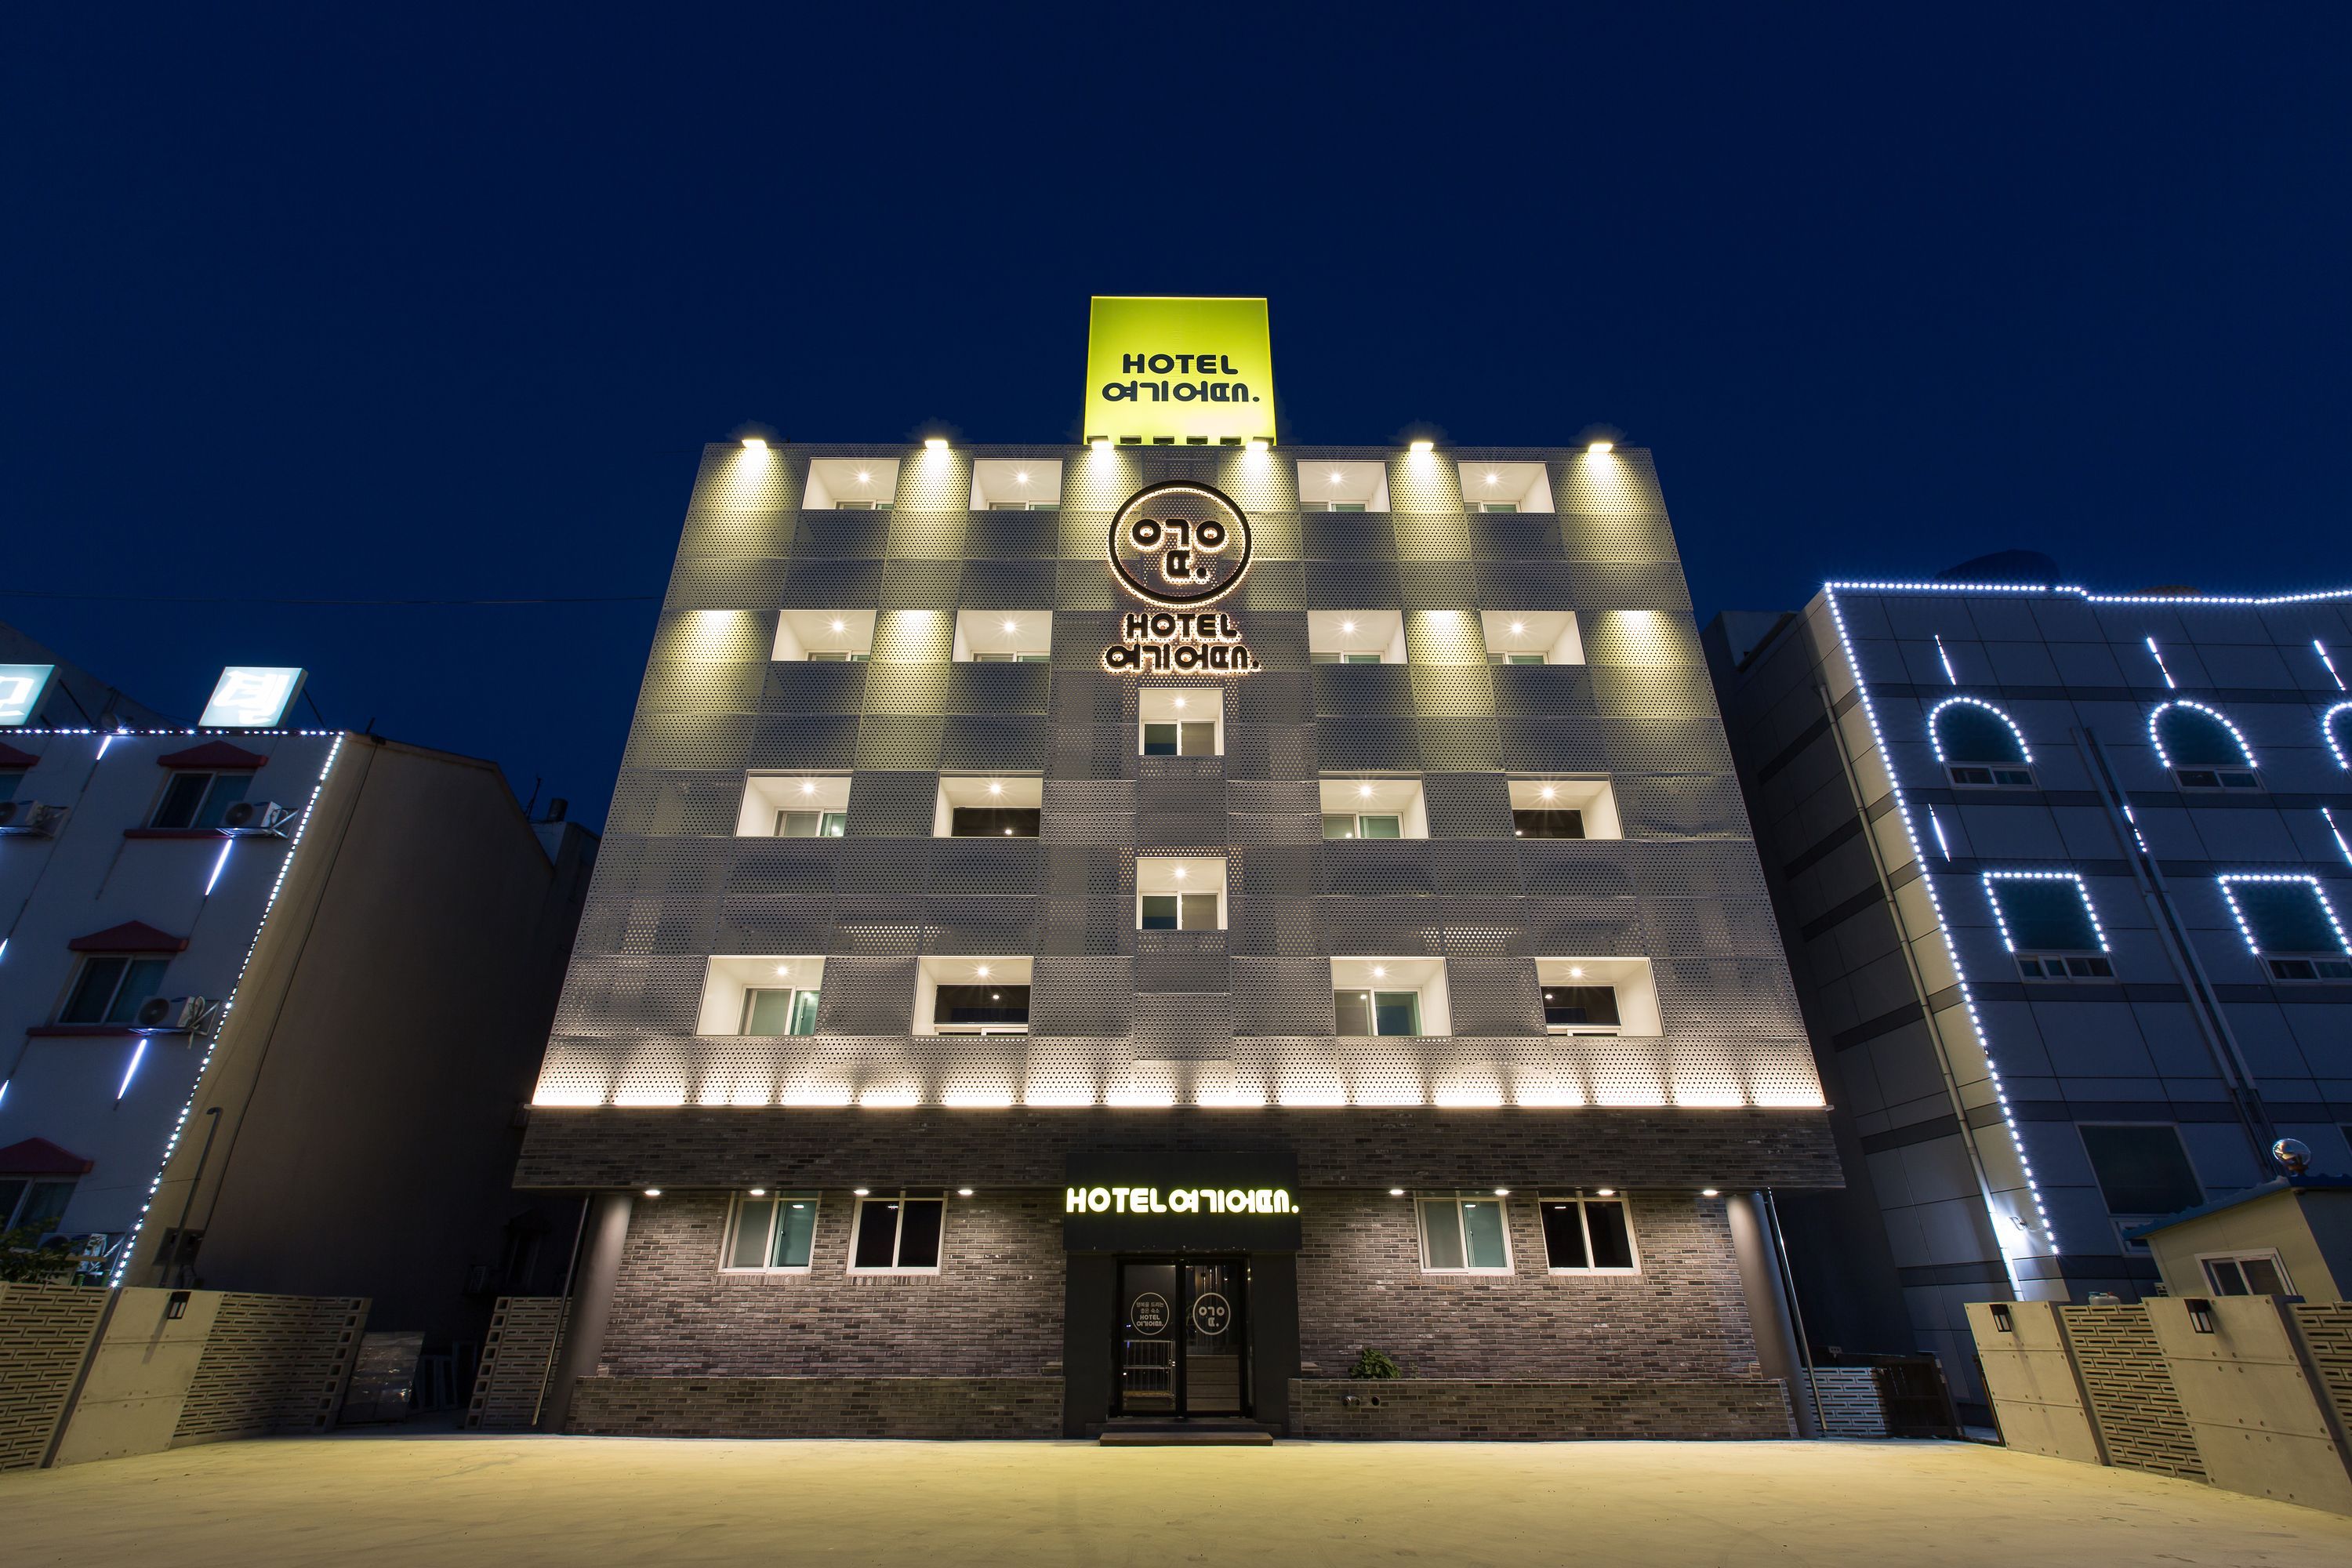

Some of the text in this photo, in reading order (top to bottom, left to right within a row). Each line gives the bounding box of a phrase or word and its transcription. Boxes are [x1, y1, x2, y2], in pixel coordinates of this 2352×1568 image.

[1122, 353, 1239, 375] HOTEL
[1127, 613, 1238, 639] HOTEL
[212, 670, 291, 724] 텔
[1065, 1187, 1167, 1213] HOTEL
